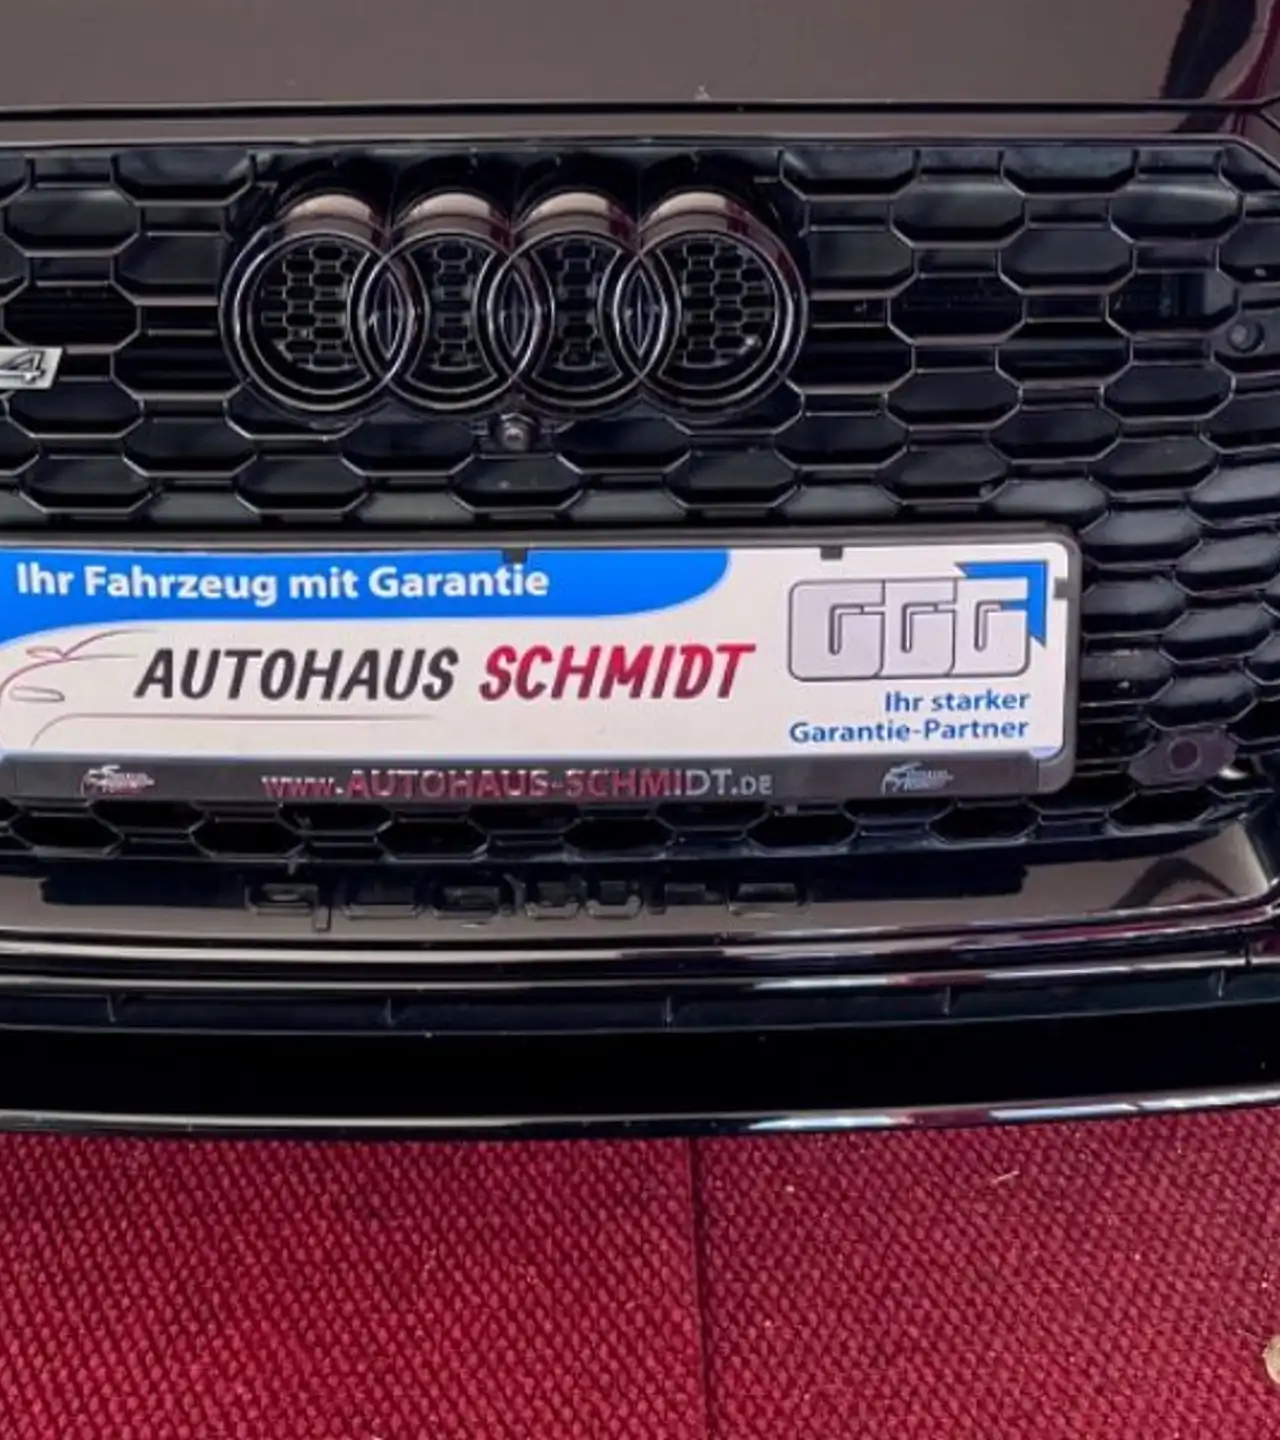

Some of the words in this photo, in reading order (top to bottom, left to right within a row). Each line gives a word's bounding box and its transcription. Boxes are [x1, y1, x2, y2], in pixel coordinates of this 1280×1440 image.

[17, 563, 74, 595] Ihr
[84, 565, 278, 608] Fahrzeug
[289, 566, 359, 599] mit
[368, 564, 550, 598] Garantie
[133, 647, 459, 702] AUTOHAUS
[478, 642, 757, 701] SCHMIDT
[884, 691, 923, 713] Ihr
[931, 689, 1031, 712] starker
[789, 719, 1030, 744] Garantie-Partner
